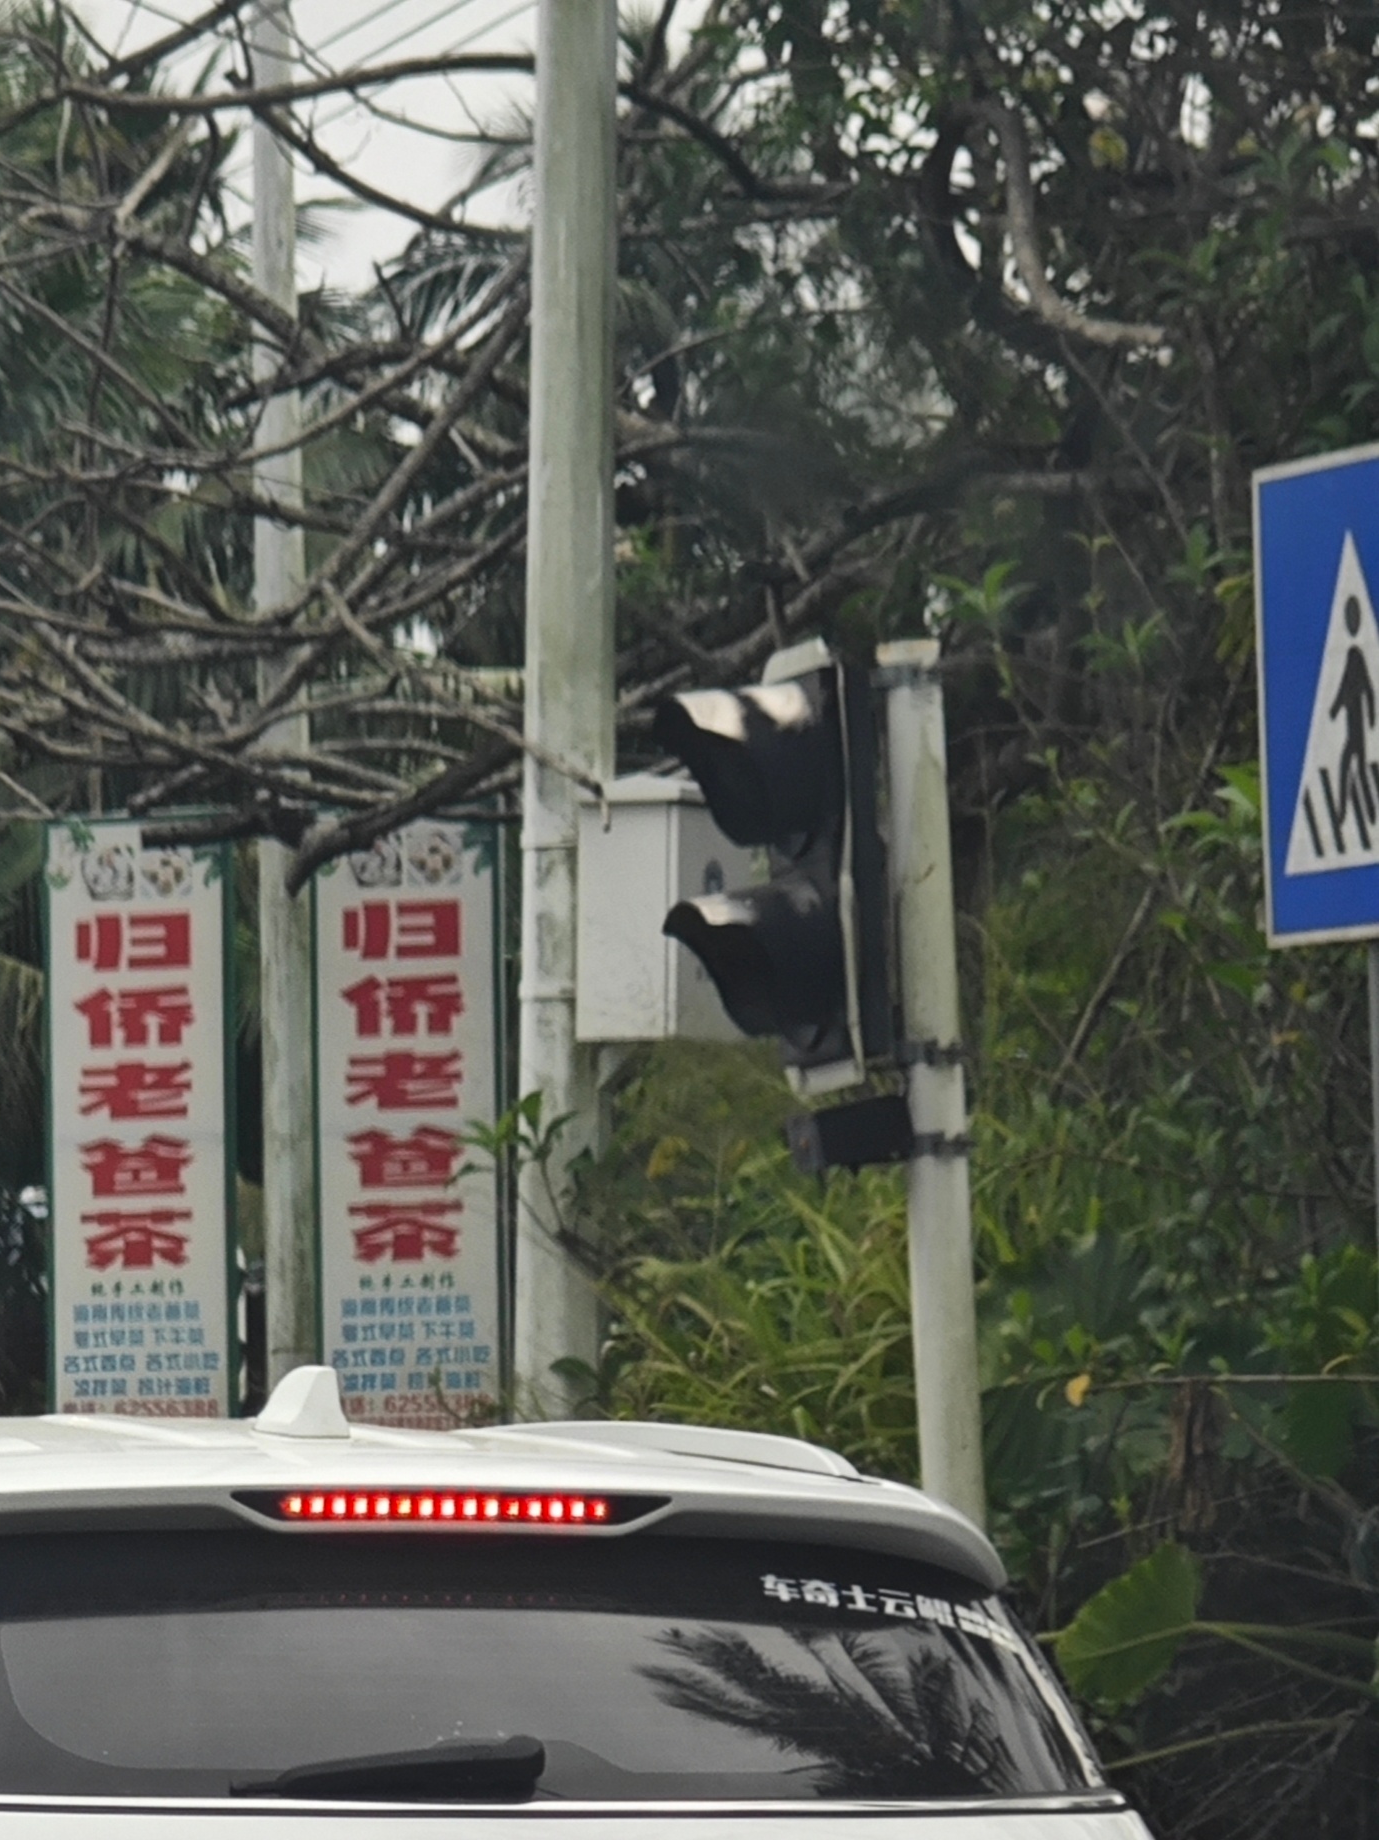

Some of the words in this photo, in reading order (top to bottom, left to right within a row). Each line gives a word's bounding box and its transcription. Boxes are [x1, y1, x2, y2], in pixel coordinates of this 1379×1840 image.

[74, 912, 195, 1271] 归侨老爸茶
[341, 899, 465, 1264] 归侨老爸茶
